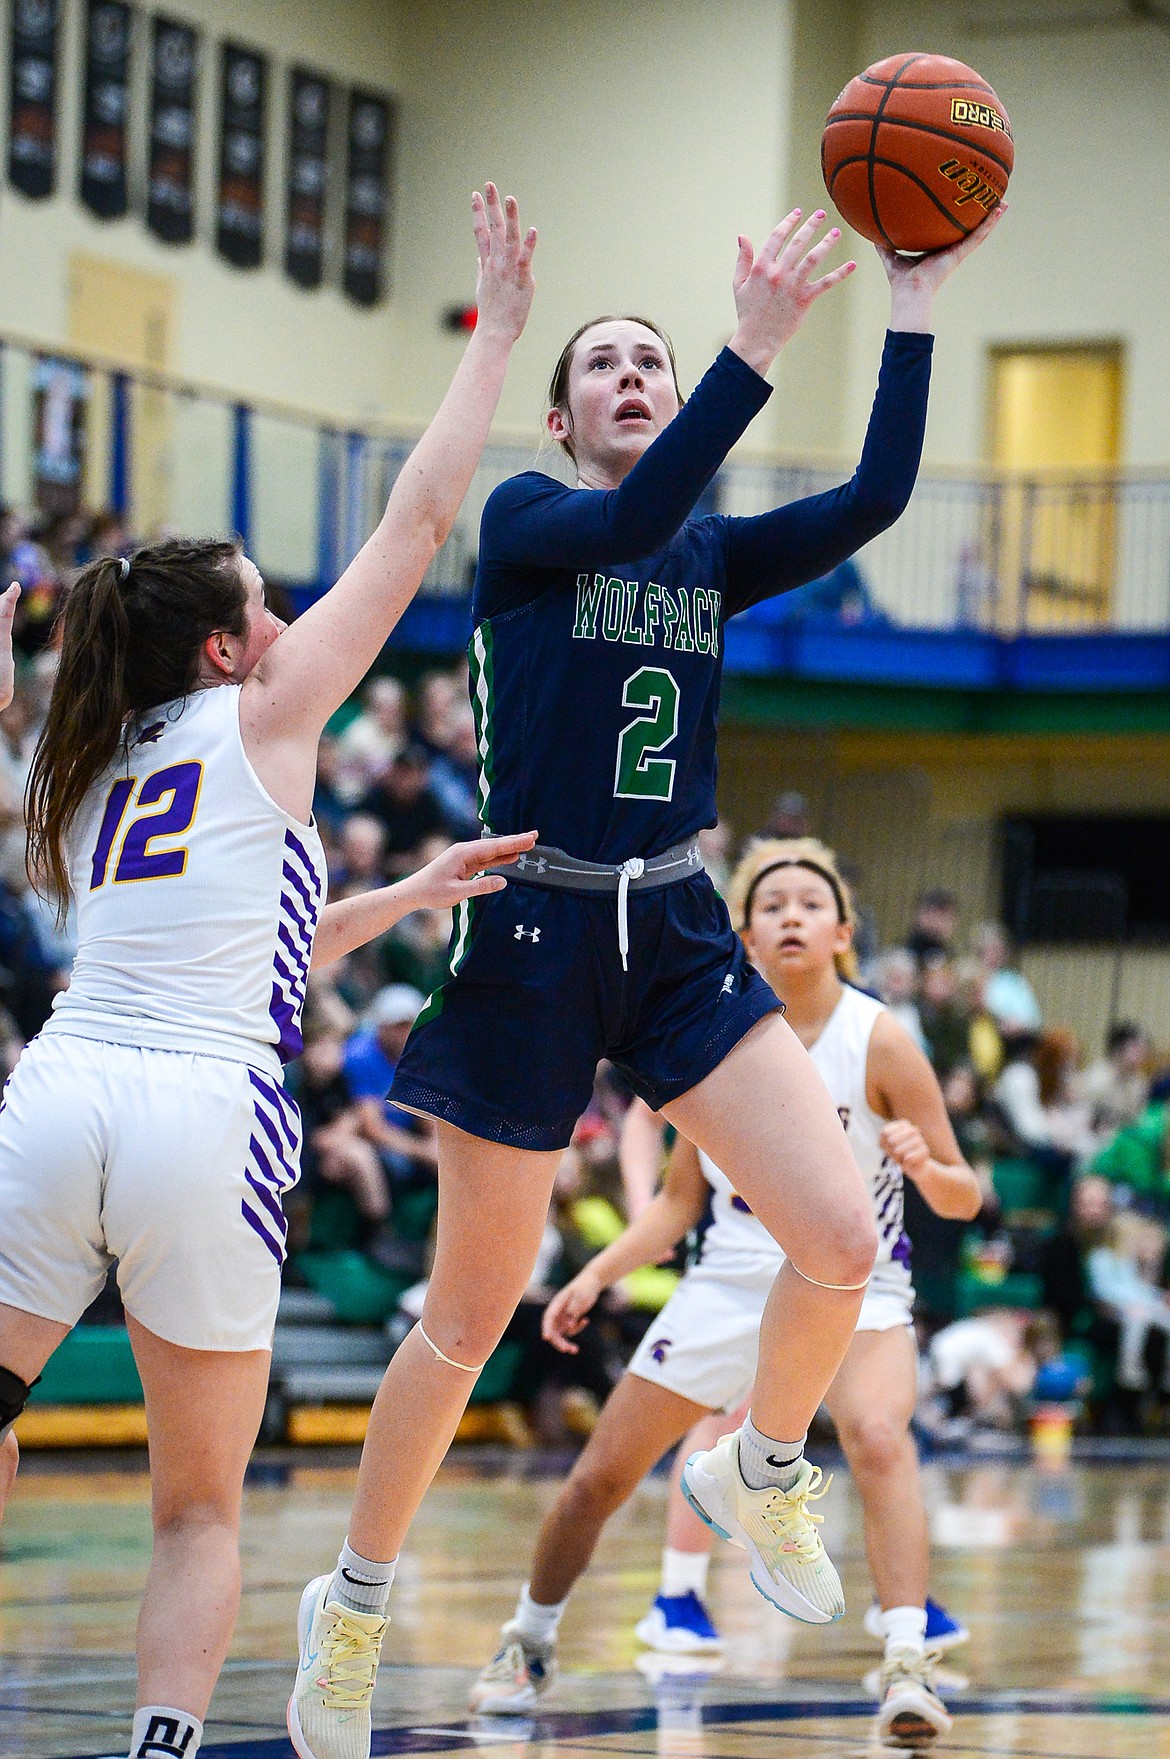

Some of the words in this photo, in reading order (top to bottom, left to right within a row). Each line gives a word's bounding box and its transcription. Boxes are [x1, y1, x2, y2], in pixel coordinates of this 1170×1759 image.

[955, 102, 990, 126] PRO
[572, 573, 721, 658] WOLFPACK
[613, 665, 681, 802] 2
[90, 759, 204, 892] 12
